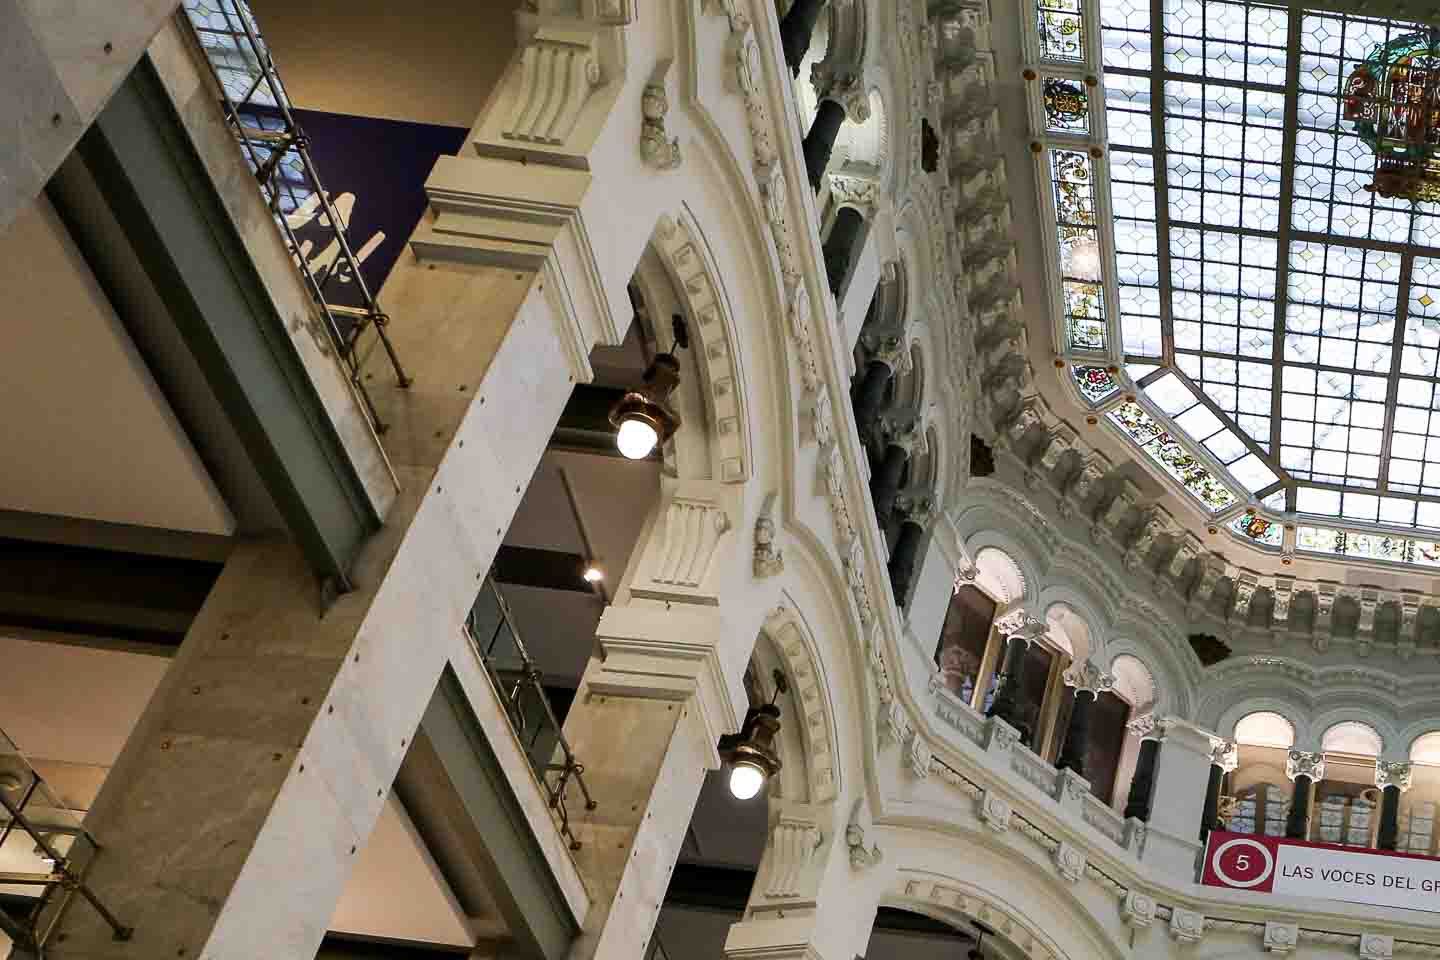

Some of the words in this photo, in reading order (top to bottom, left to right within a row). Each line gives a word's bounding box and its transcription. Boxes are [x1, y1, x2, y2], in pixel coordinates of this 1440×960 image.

[1235, 855, 1250, 871] 5
[1282, 864, 1314, 879] LAS
[1320, 869, 1376, 886] VOCES
[1382, 875, 1417, 890] DEL
